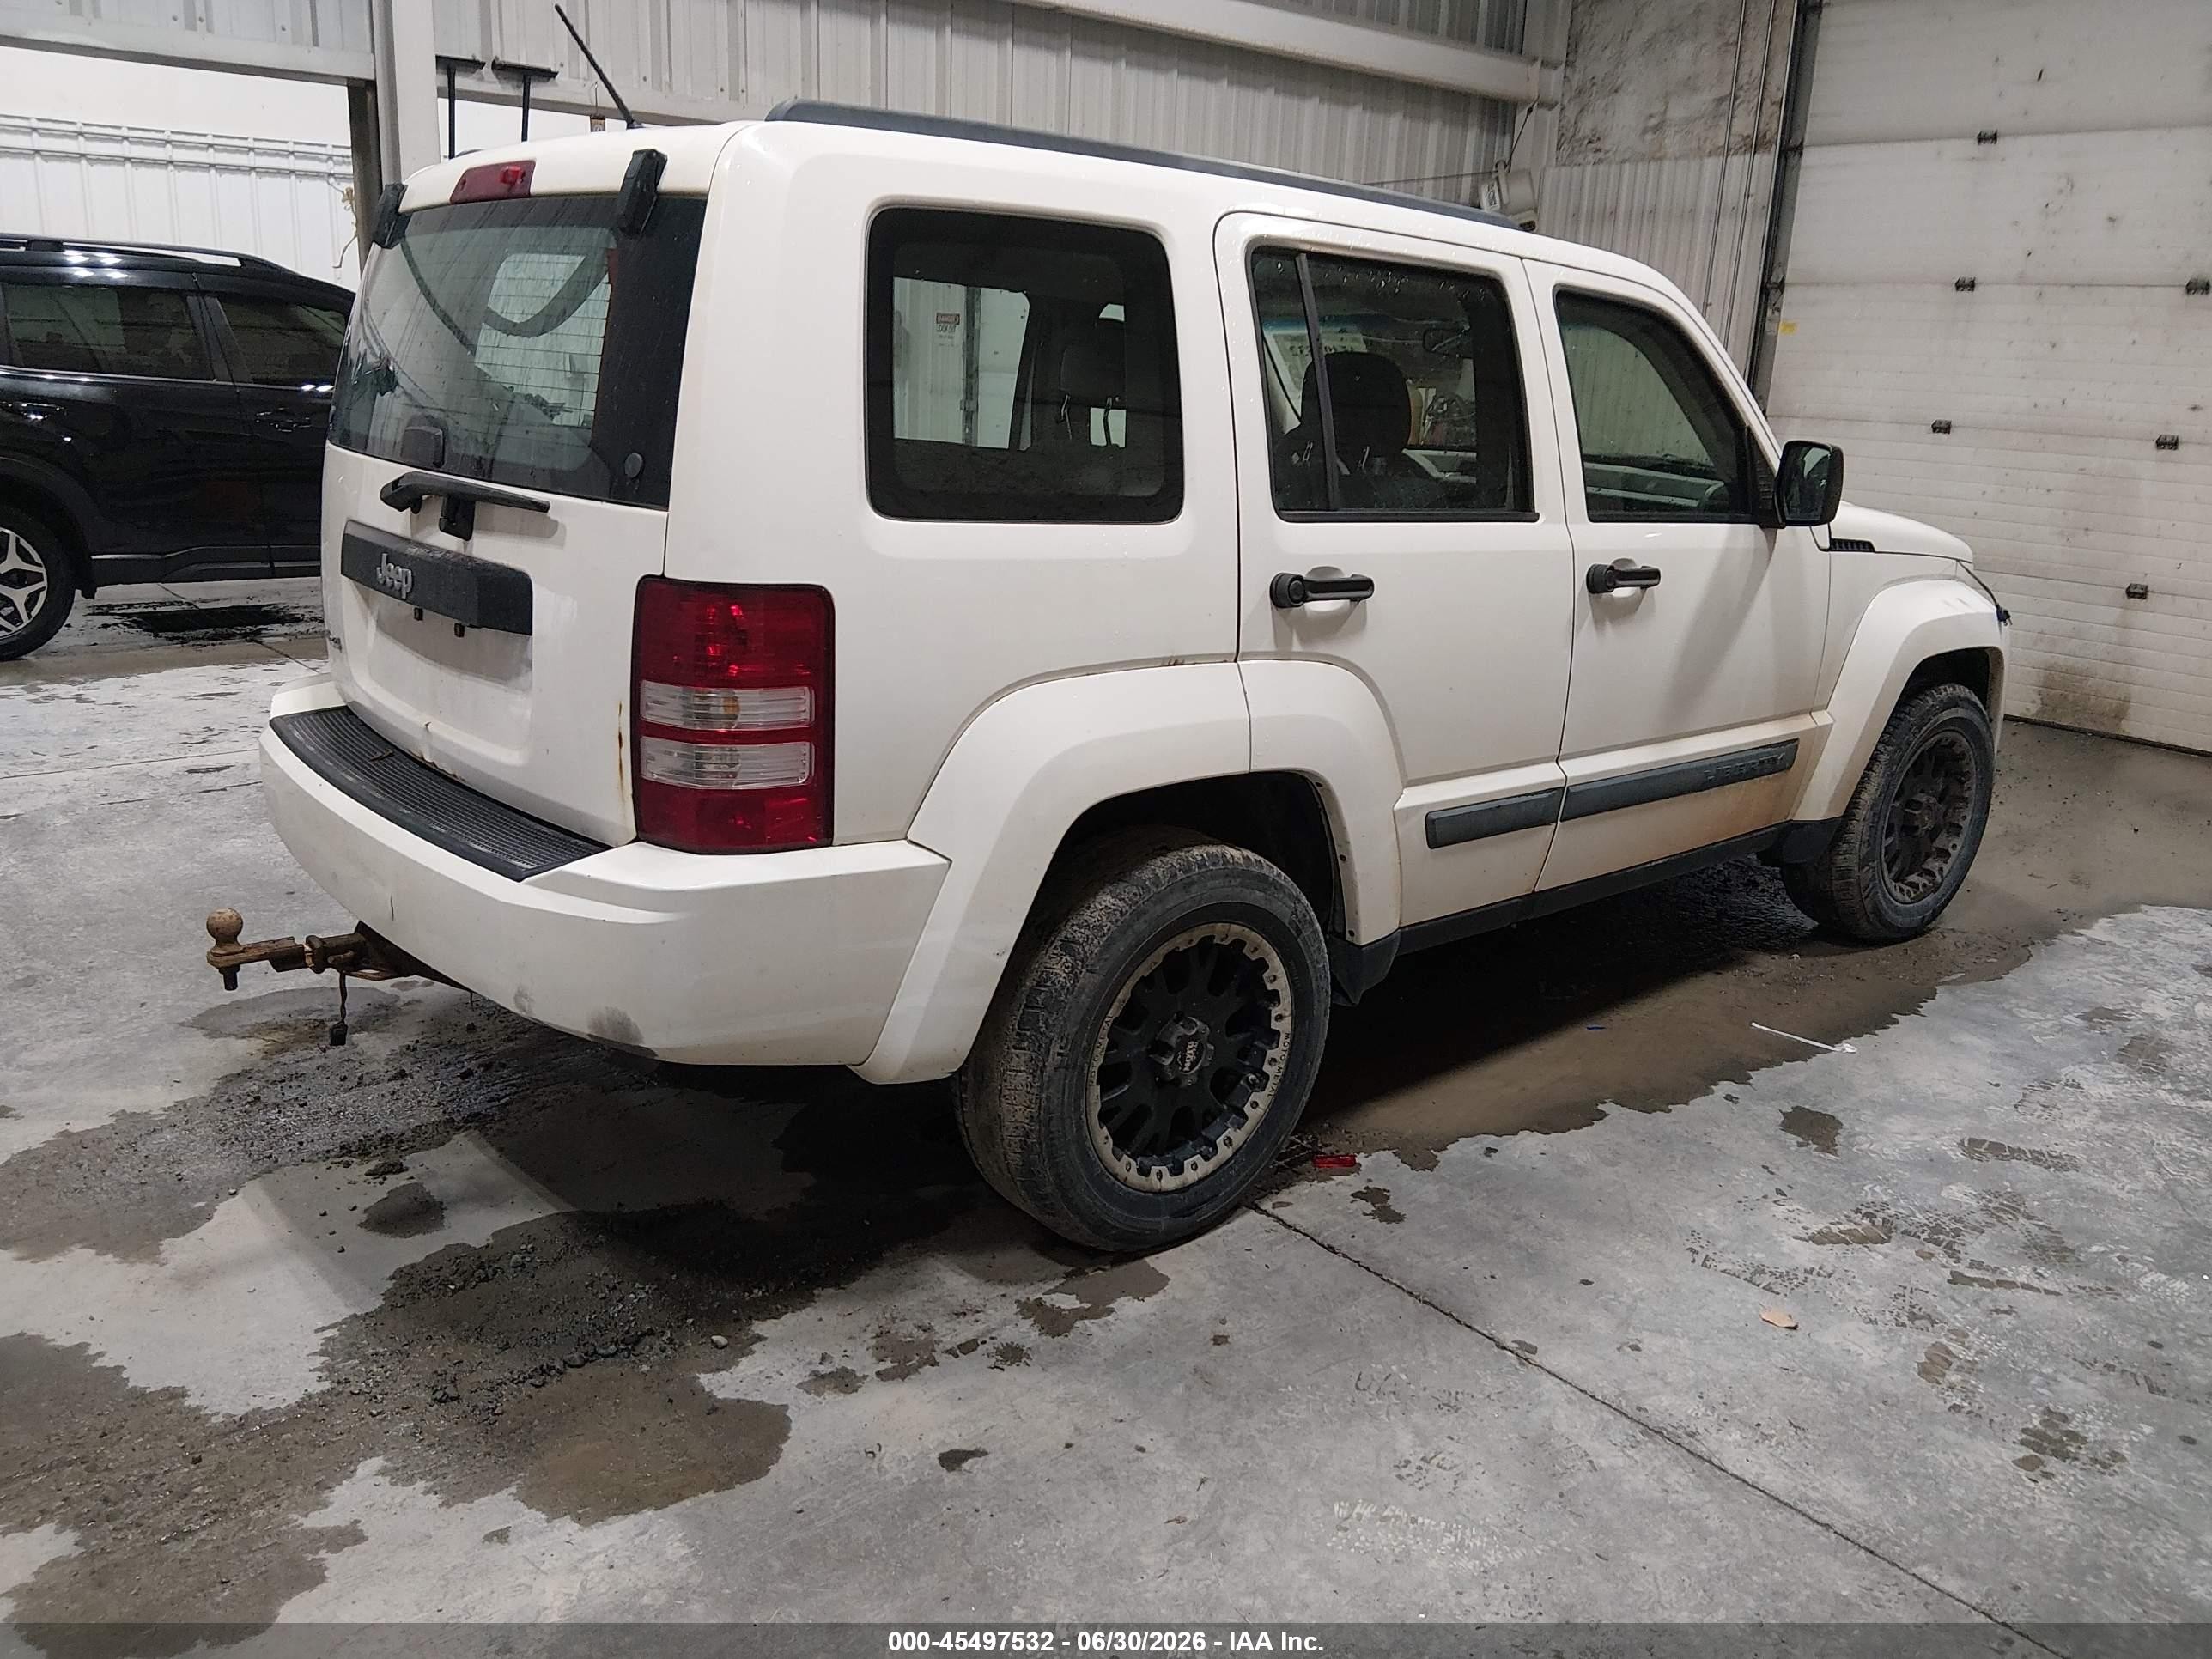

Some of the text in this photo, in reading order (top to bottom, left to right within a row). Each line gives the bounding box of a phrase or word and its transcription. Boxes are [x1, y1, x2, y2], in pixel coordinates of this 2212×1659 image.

[376, 553, 413, 599] Jeep
[1704, 753, 1785, 781] LIBERTY
[1267, 1032, 1290, 1098] MOTO METAL
